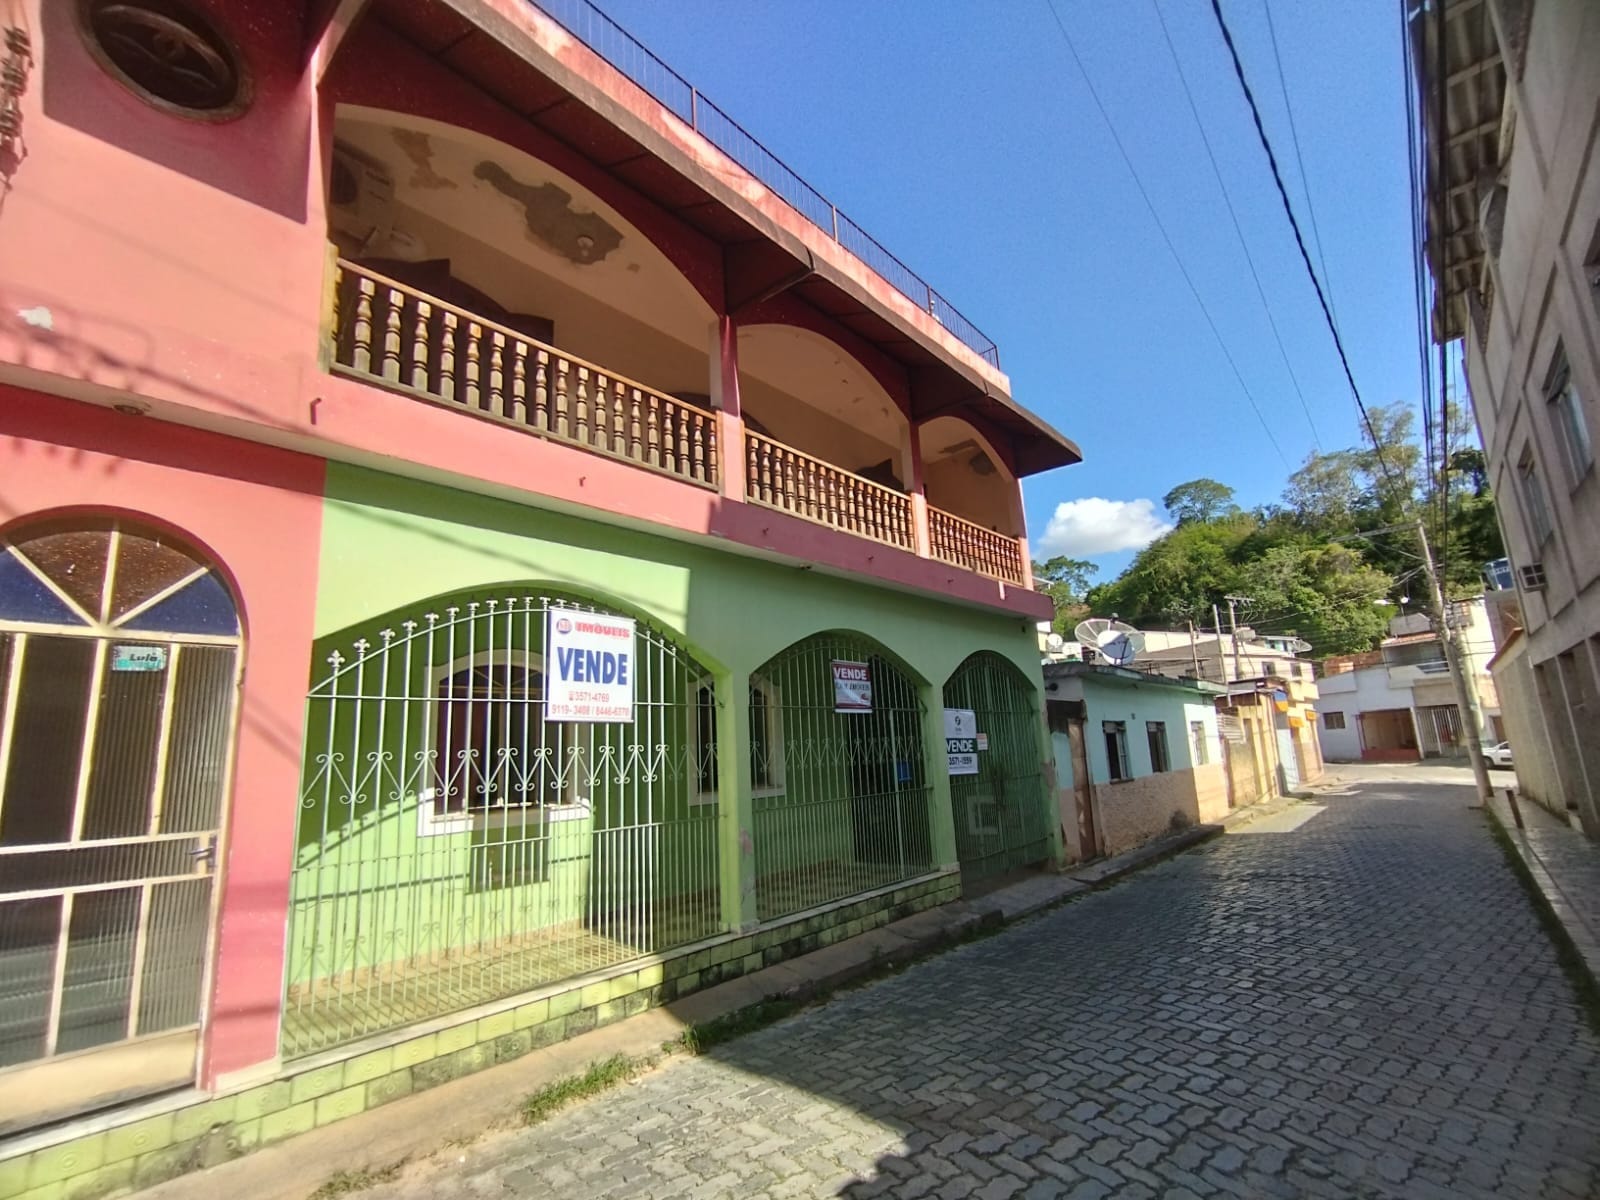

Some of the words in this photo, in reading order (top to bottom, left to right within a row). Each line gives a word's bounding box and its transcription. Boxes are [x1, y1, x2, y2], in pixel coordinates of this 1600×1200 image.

[557, 646, 628, 685] VENDE
[833, 667, 867, 680] VENDE
[946, 740, 974, 752] VENDE
